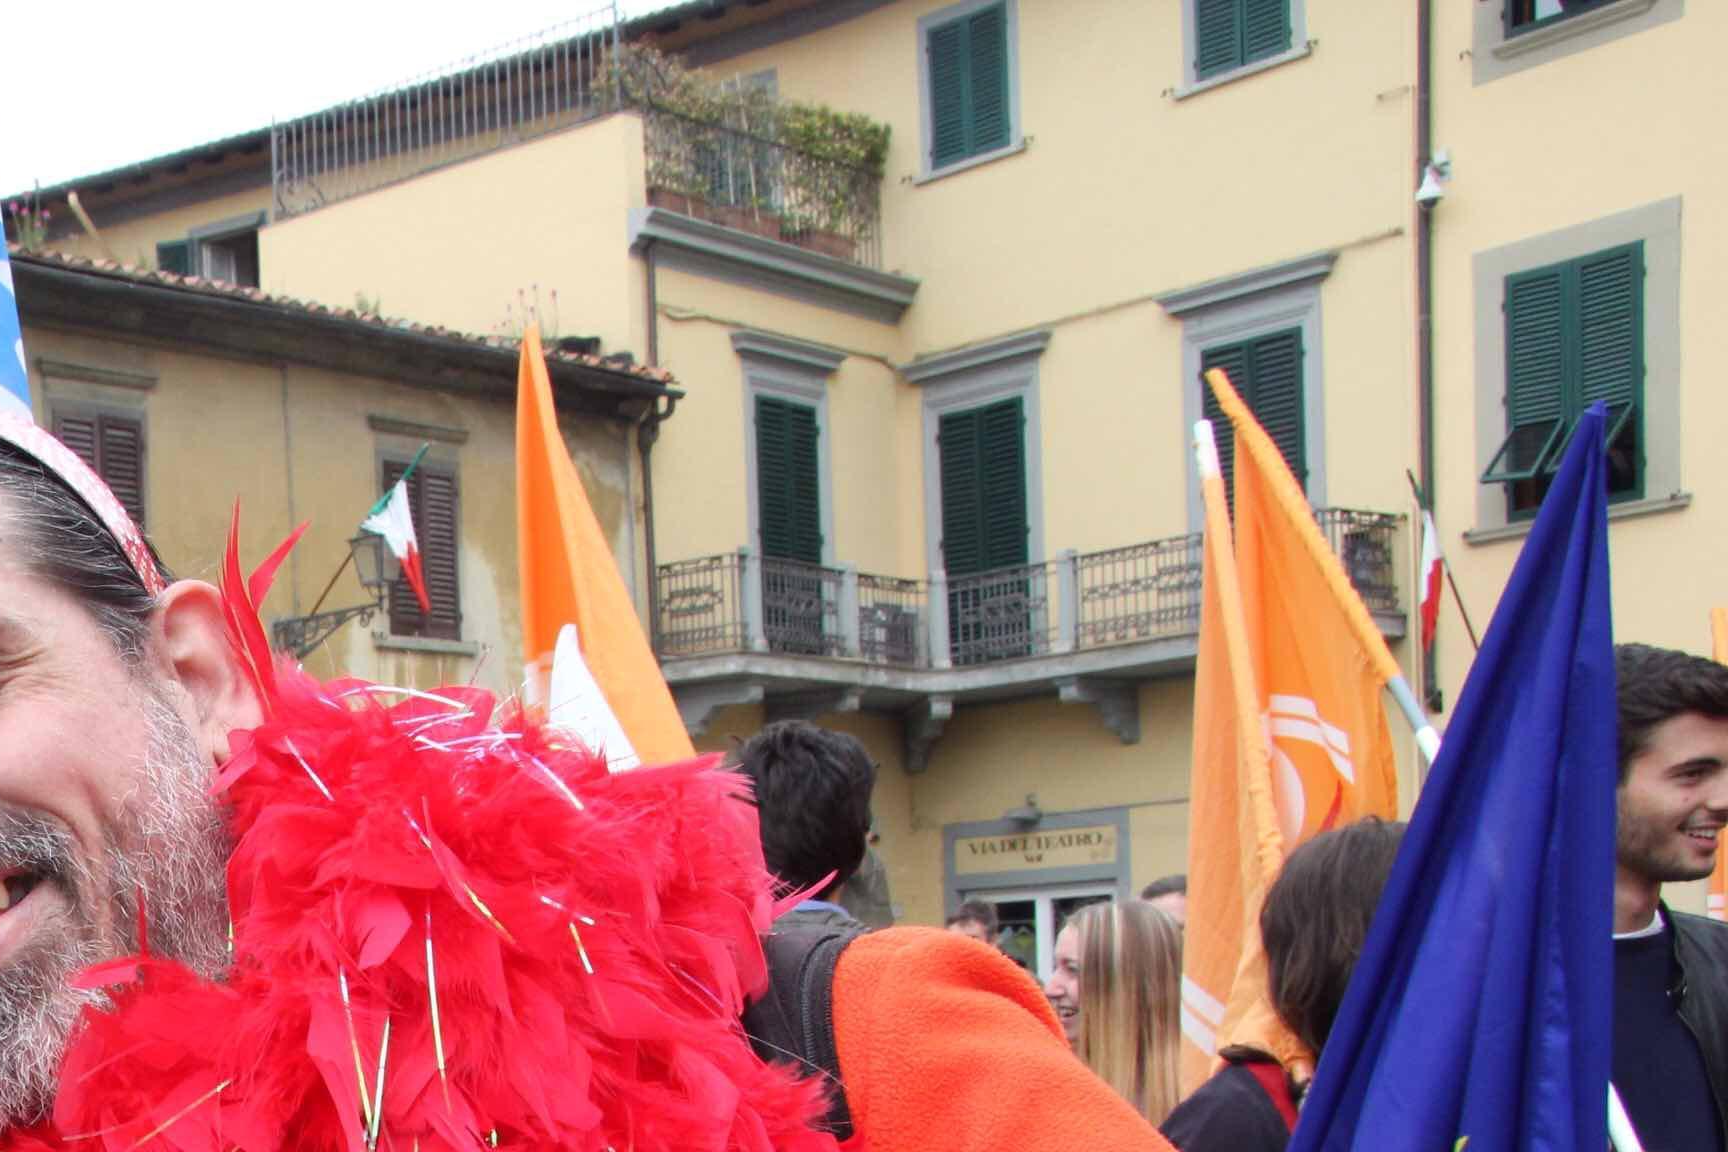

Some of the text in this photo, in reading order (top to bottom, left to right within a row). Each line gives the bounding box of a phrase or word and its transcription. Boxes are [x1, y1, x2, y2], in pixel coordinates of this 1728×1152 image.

[968, 831, 1103, 855] VIA DEL TEATRO
